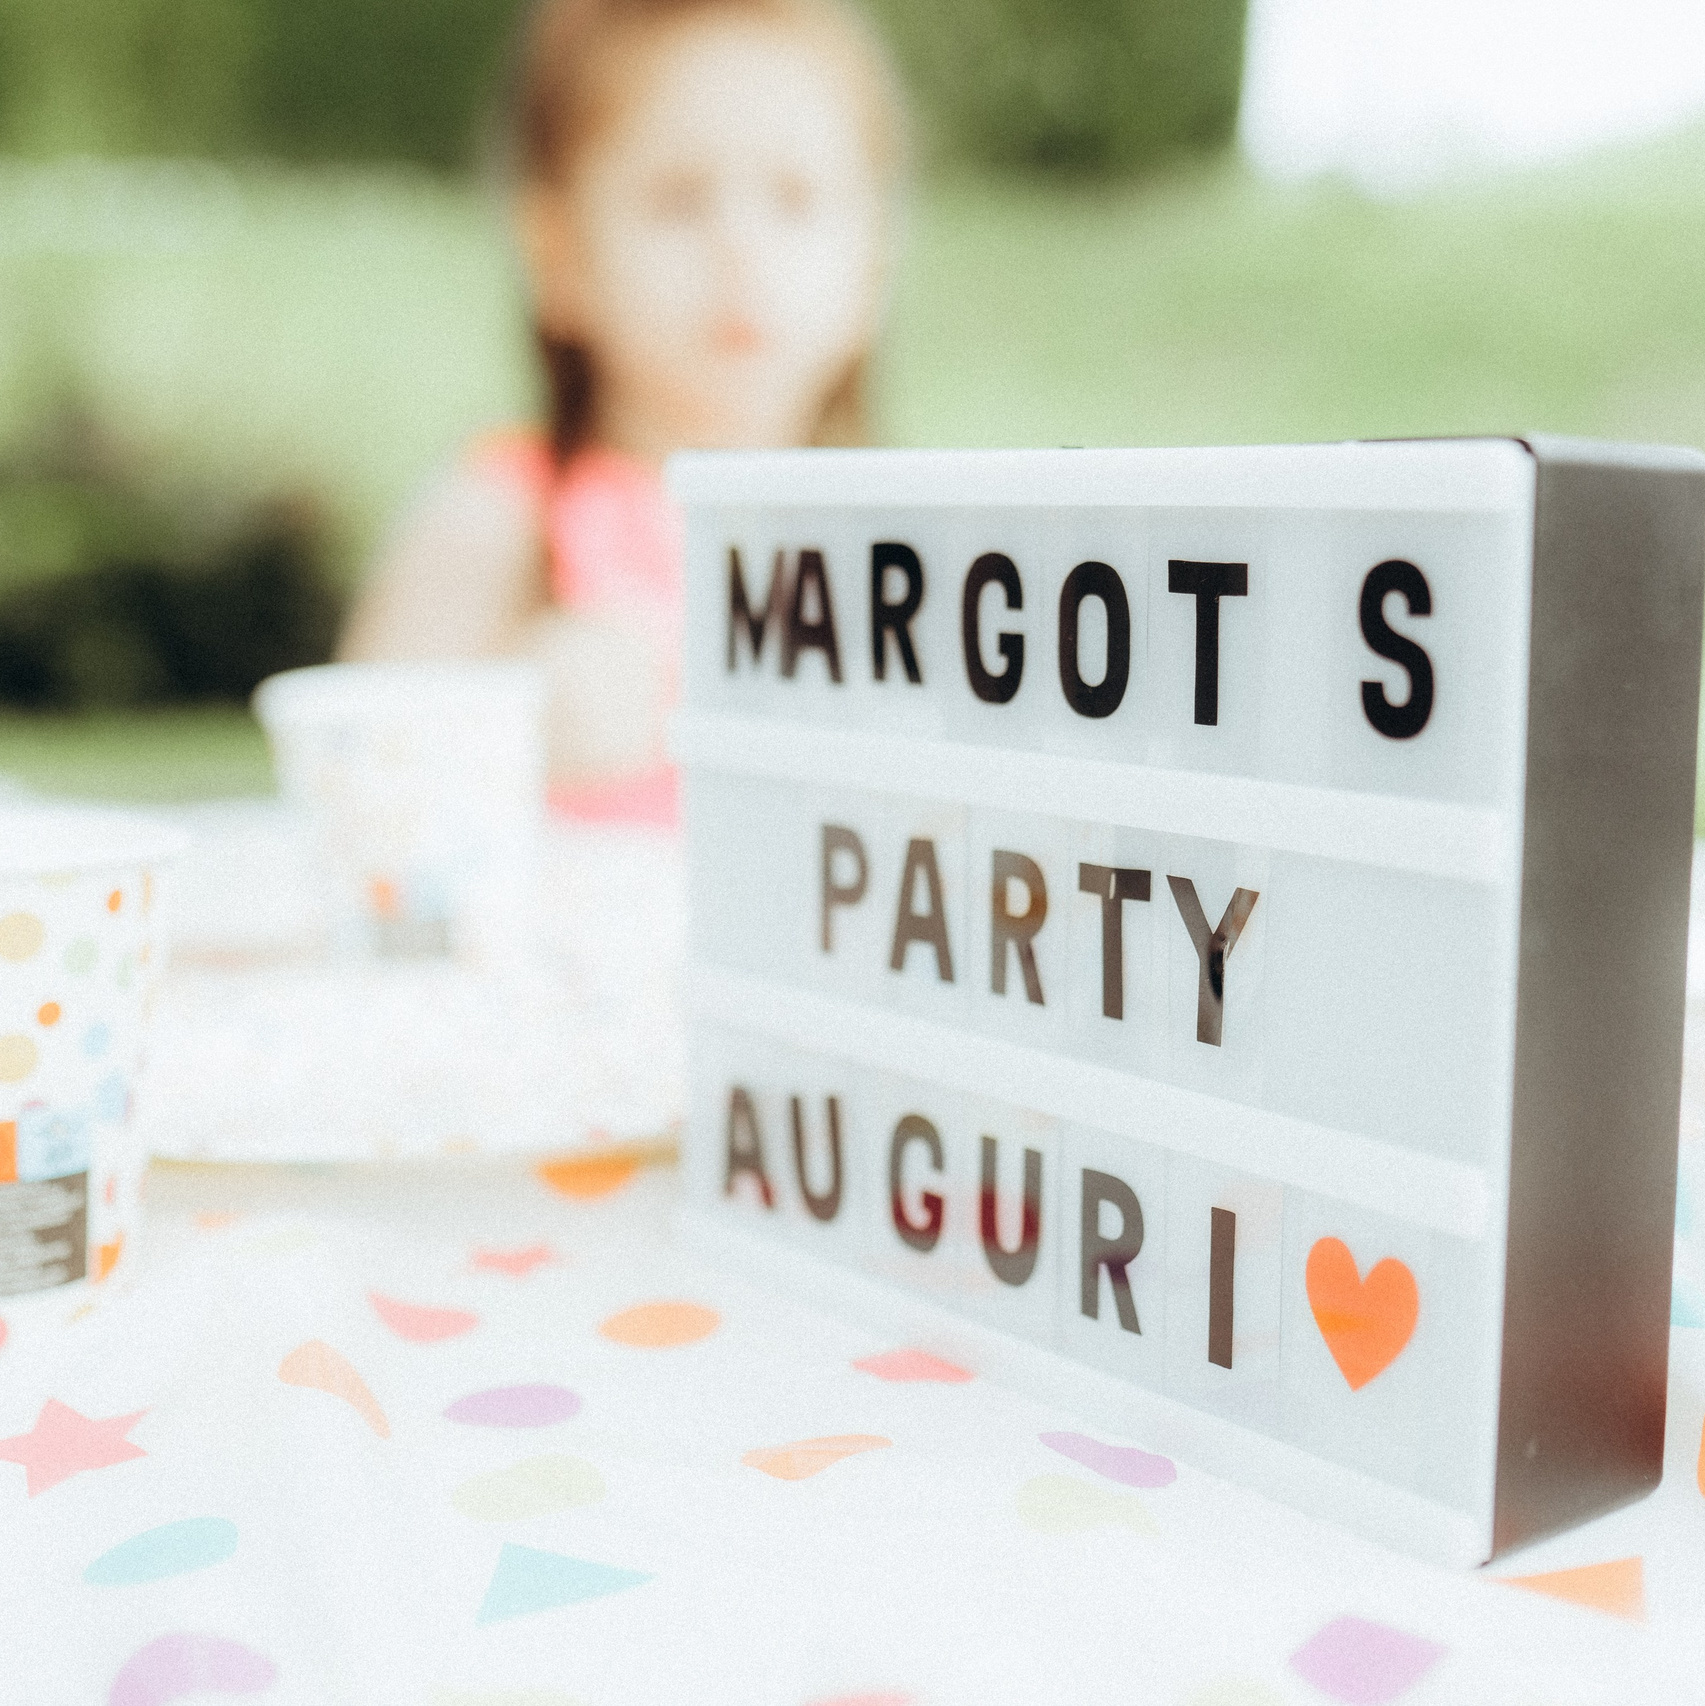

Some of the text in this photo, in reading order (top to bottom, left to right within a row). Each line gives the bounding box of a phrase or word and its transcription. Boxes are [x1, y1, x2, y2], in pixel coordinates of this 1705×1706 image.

[725, 540, 1437, 742] MARGOT S
[820, 823, 1260, 1047] PARTY
[724, 1085, 1236, 1369] AUGURI
